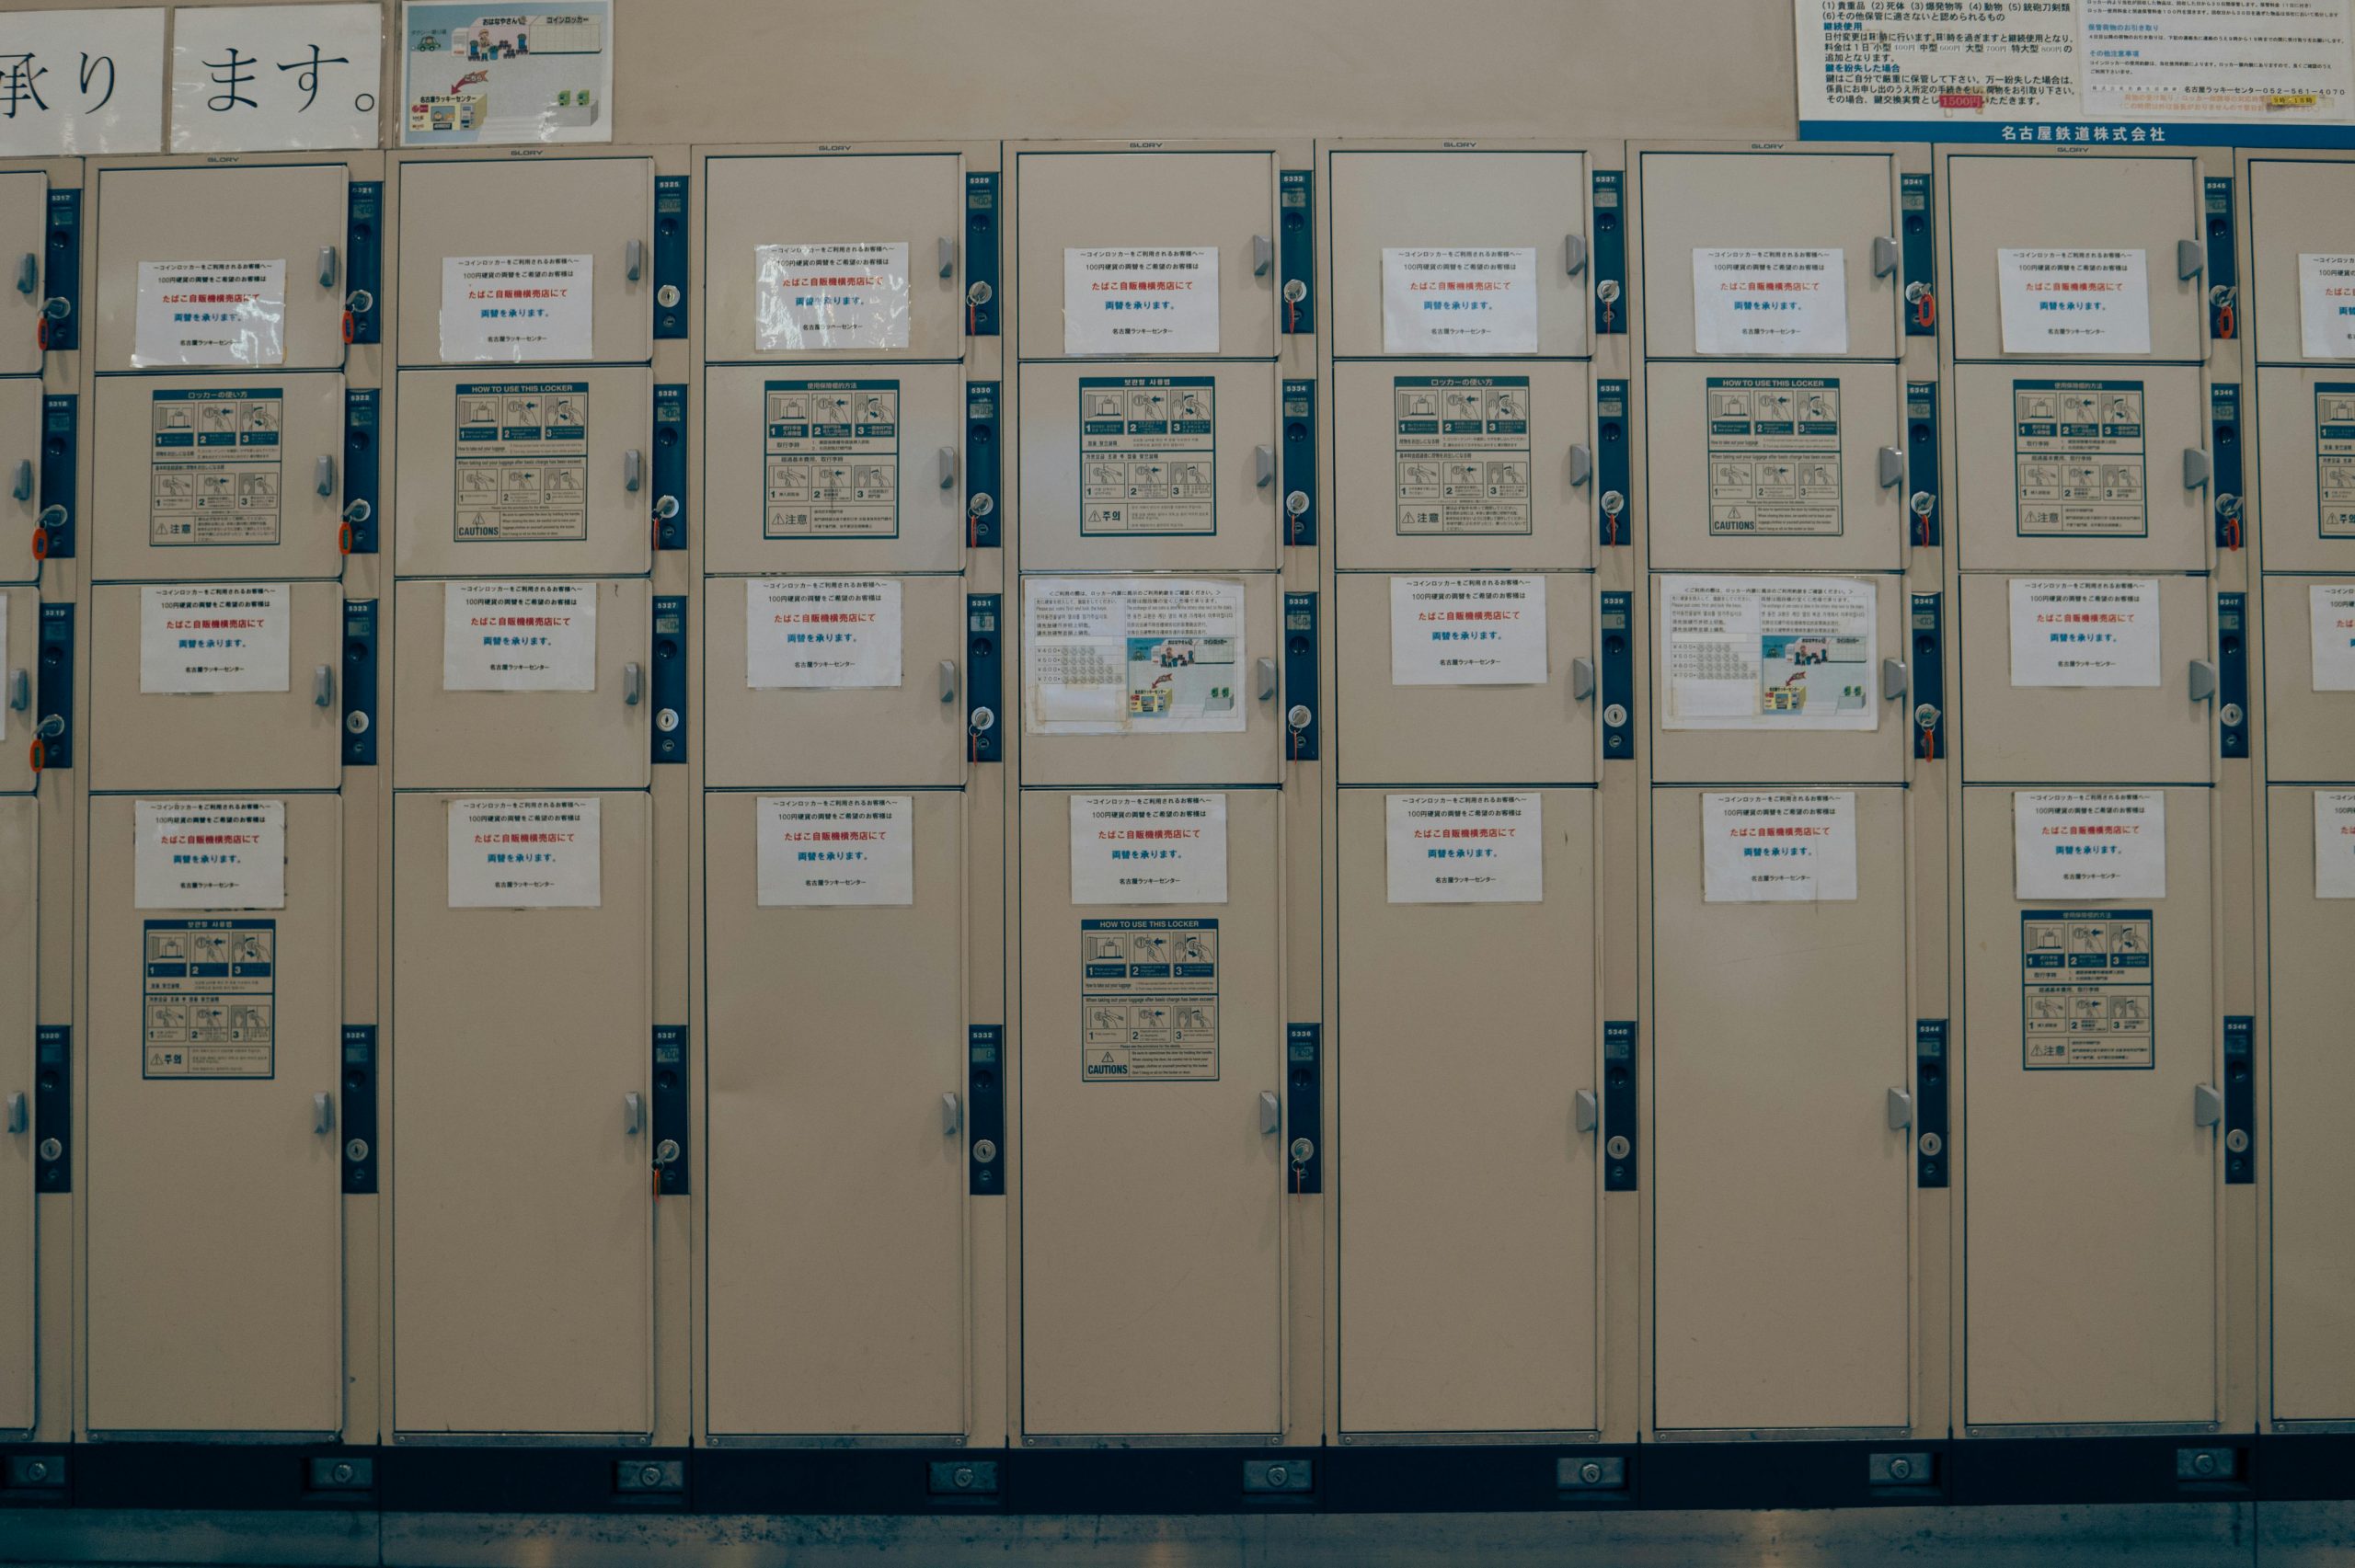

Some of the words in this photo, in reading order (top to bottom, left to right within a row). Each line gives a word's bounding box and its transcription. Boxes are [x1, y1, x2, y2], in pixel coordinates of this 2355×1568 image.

[483, 17, 518, 26] おはなやさん
[546, 16, 589, 24] コインロッカー
[0, 52, 115, 118] 承り
[201, 44, 374, 113] ます。
[420, 95, 477, 104] 名古屋ラッキーセンター
[2001, 126, 2165, 141] 名古屋鉄道株式会社
[782, 277, 883, 287] たばこ自販機横売店にて
[1091, 280, 1193, 291] たばこ自販機横売店にて
[1410, 281, 1511, 291] たばこ自販機横売店にて
[1720, 281, 1820, 292] たばこ自販機横売店にて
[2026, 282, 2123, 292] たばこ自販機横売店にて
[468, 289, 568, 299] たばこ自販機横売店にて
[1105, 301, 1174, 311] 両替を承ります。
[1423, 301, 1492, 311] 両替を承ります。
[1733, 301, 1801, 311] 両替を承ります。
[2039, 301, 2106, 311] 両替を承ります。
[480, 308, 548, 318] 両替を承ります。
[1430, 327, 1492, 336] 名古屋ラッキーセンター
[2047, 327, 2105, 336] 名古屋ラッキーセンター
[786, 515, 808, 524] 注意
[1102, 511, 1120, 521] 주의
[1418, 513, 1439, 523] 注意
[170, 524, 191, 533] 注意
[1715, 521, 1754, 530] CAUTIONS
[459, 527, 499, 535] CAUTIONS
[470, 616, 571, 626] たばこ自販機横売店にて
[774, 613, 876, 624] たばこ自販機横売店にて
[1419, 611, 1521, 621] たばこ自販機横売店にて
[2037, 613, 2135, 624] たばこ自販機横売店にて
[166, 619, 265, 629] たばこ自販機横売店にて
[483, 635, 552, 647] 両替を承ります。
[787, 633, 856, 643] 両替を承ります。
[1431, 631, 1502, 641] 両替を承ります。
[2049, 633, 2117, 643] 両替を承ります。
[178, 639, 246, 649] 両替を承ります。
[489, 663, 550, 671] 名古屋ラッキーセンター
[1098, 829, 1200, 840] たばこ自販機横売店にて
[1414, 828, 1516, 839] たばこ自販機横売店にて
[1729, 827, 1831, 837] たばこ自販機横売店にて
[2041, 825, 2140, 835] たばこ自販機横売店にて
[161, 834, 260, 845] たばこ自販機横売店にて
[474, 833, 575, 843] たばこ自販機横売店にて
[784, 831, 887, 841] たばこ自販機横売店にて
[1111, 850, 1182, 860] 両替を承ります。
[1427, 848, 1497, 859] 両替を承ります。
[1743, 846, 1811, 857] 両替を承ります。
[2055, 845, 2121, 855] 両替を承ります。
[173, 854, 241, 864] 両替を承ります。
[487, 853, 556, 864] 両替を承ります。
[798, 851, 867, 862] 両替を承ります。
[1087, 1065, 1128, 1074] CAUTIONS
